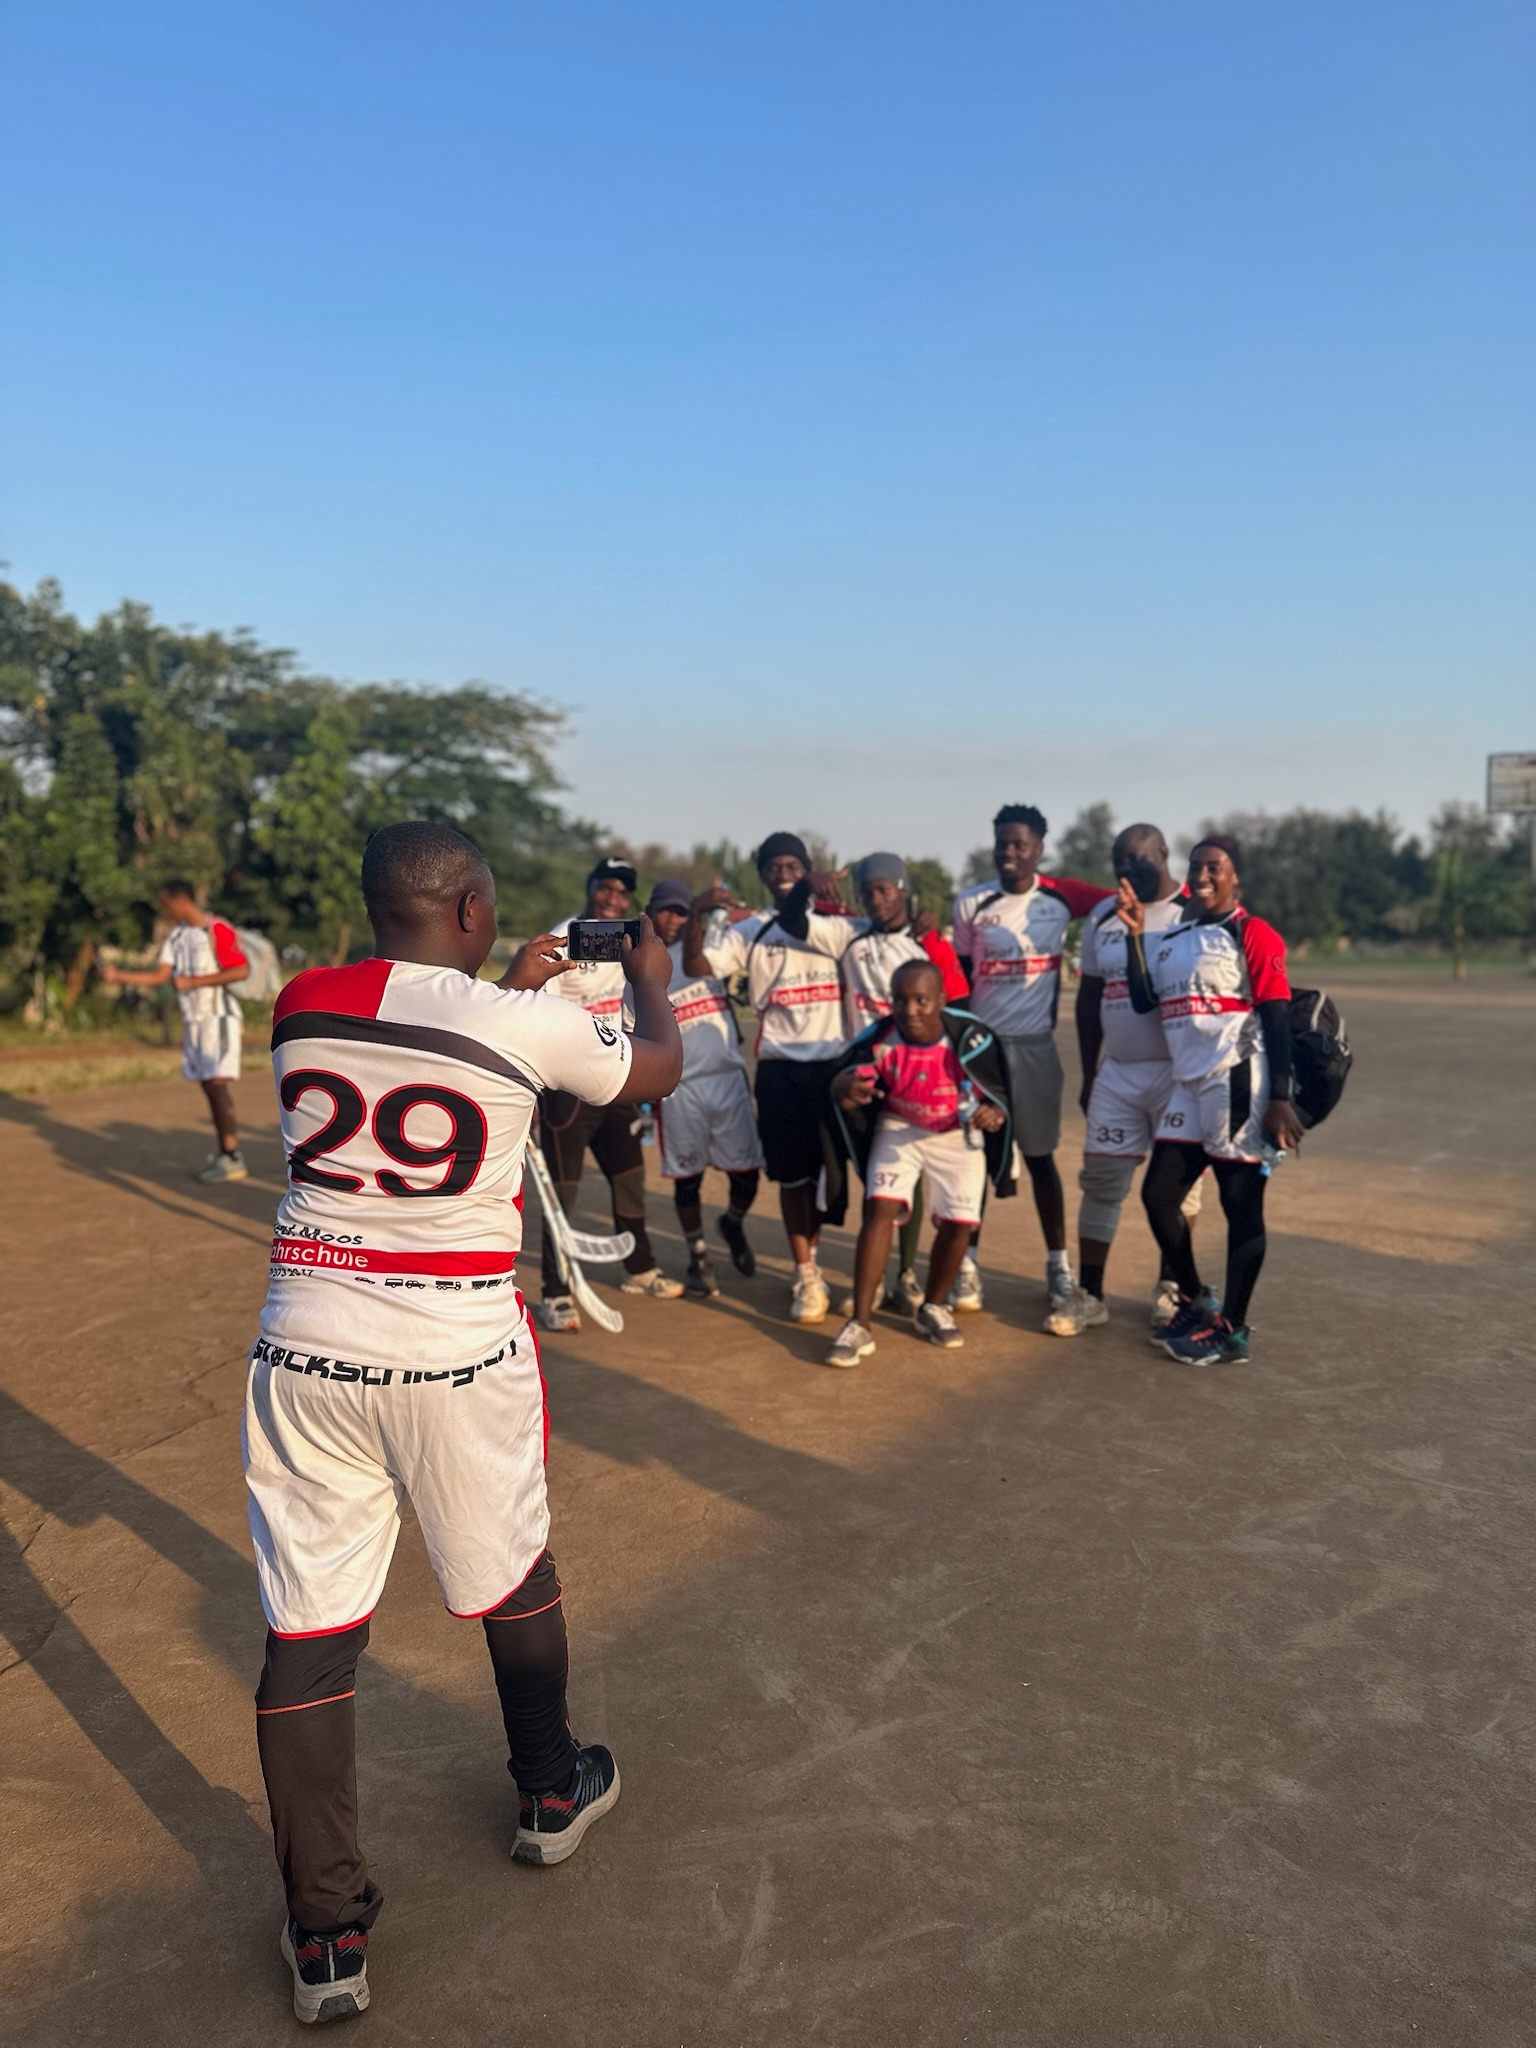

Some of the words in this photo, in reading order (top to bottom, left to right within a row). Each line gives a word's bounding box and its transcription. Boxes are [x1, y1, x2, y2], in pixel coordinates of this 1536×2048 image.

[1103, 929, 1124, 945] 72
[1164, 1112, 1184, 1129] 16
[280, 1068, 488, 1198] 29
[1097, 1127, 1124, 1145] 33
[678, 1154, 698, 1168] 26
[874, 1172, 899, 1188] 37
